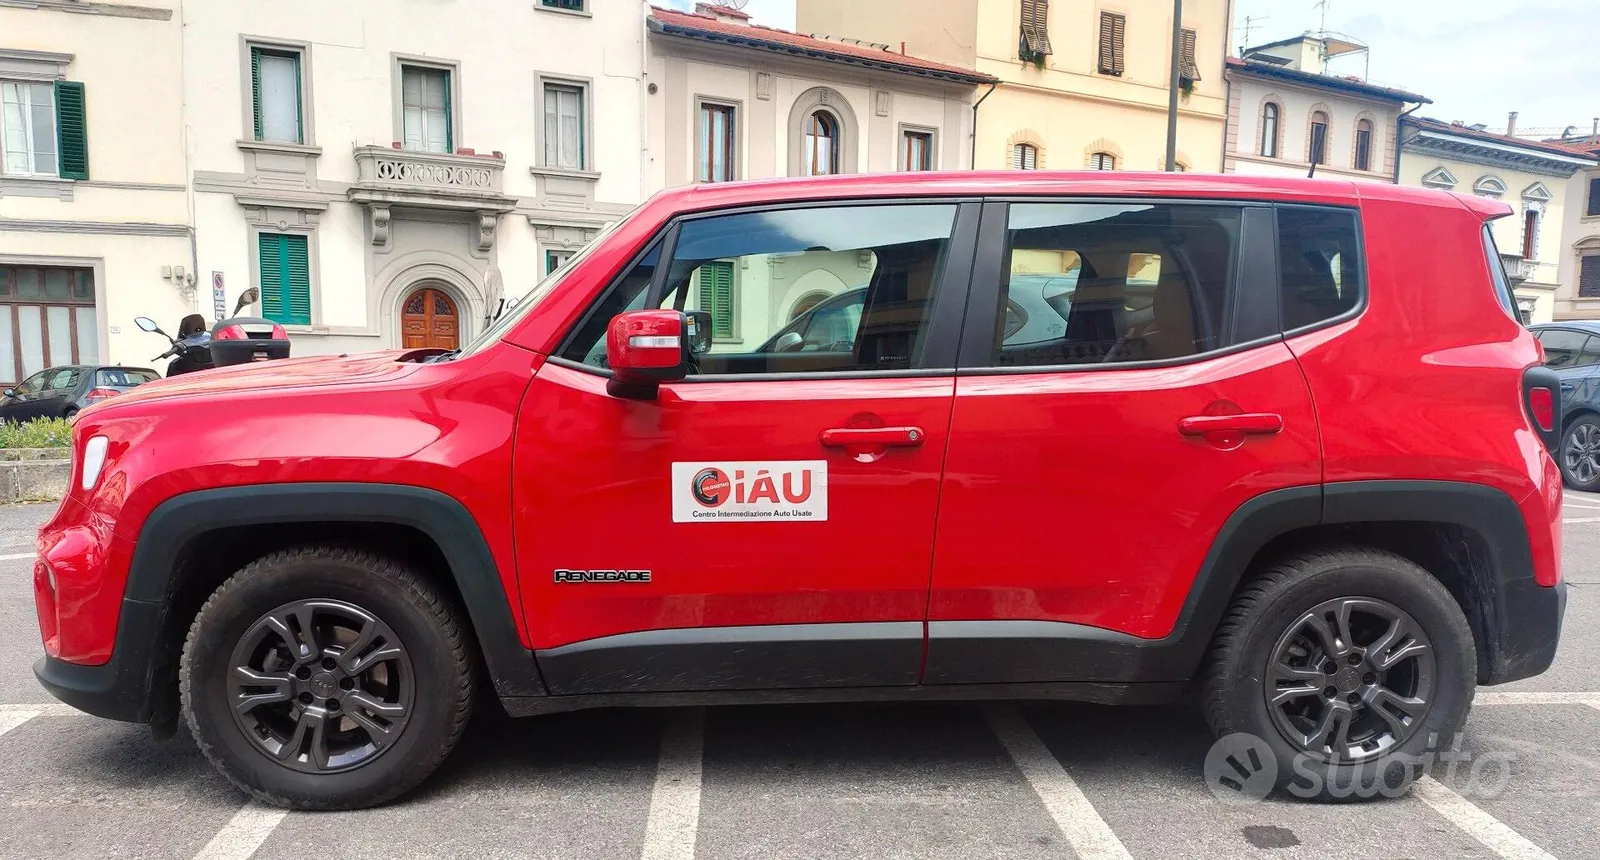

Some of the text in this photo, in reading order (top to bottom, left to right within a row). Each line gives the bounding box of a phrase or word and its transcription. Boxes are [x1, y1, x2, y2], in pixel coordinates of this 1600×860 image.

[692, 510, 717, 518] Centro
[717, 510, 772, 518] Intermediazione
[792, 509, 813, 517] Usate
[554, 569, 651, 582] RENEGADE
